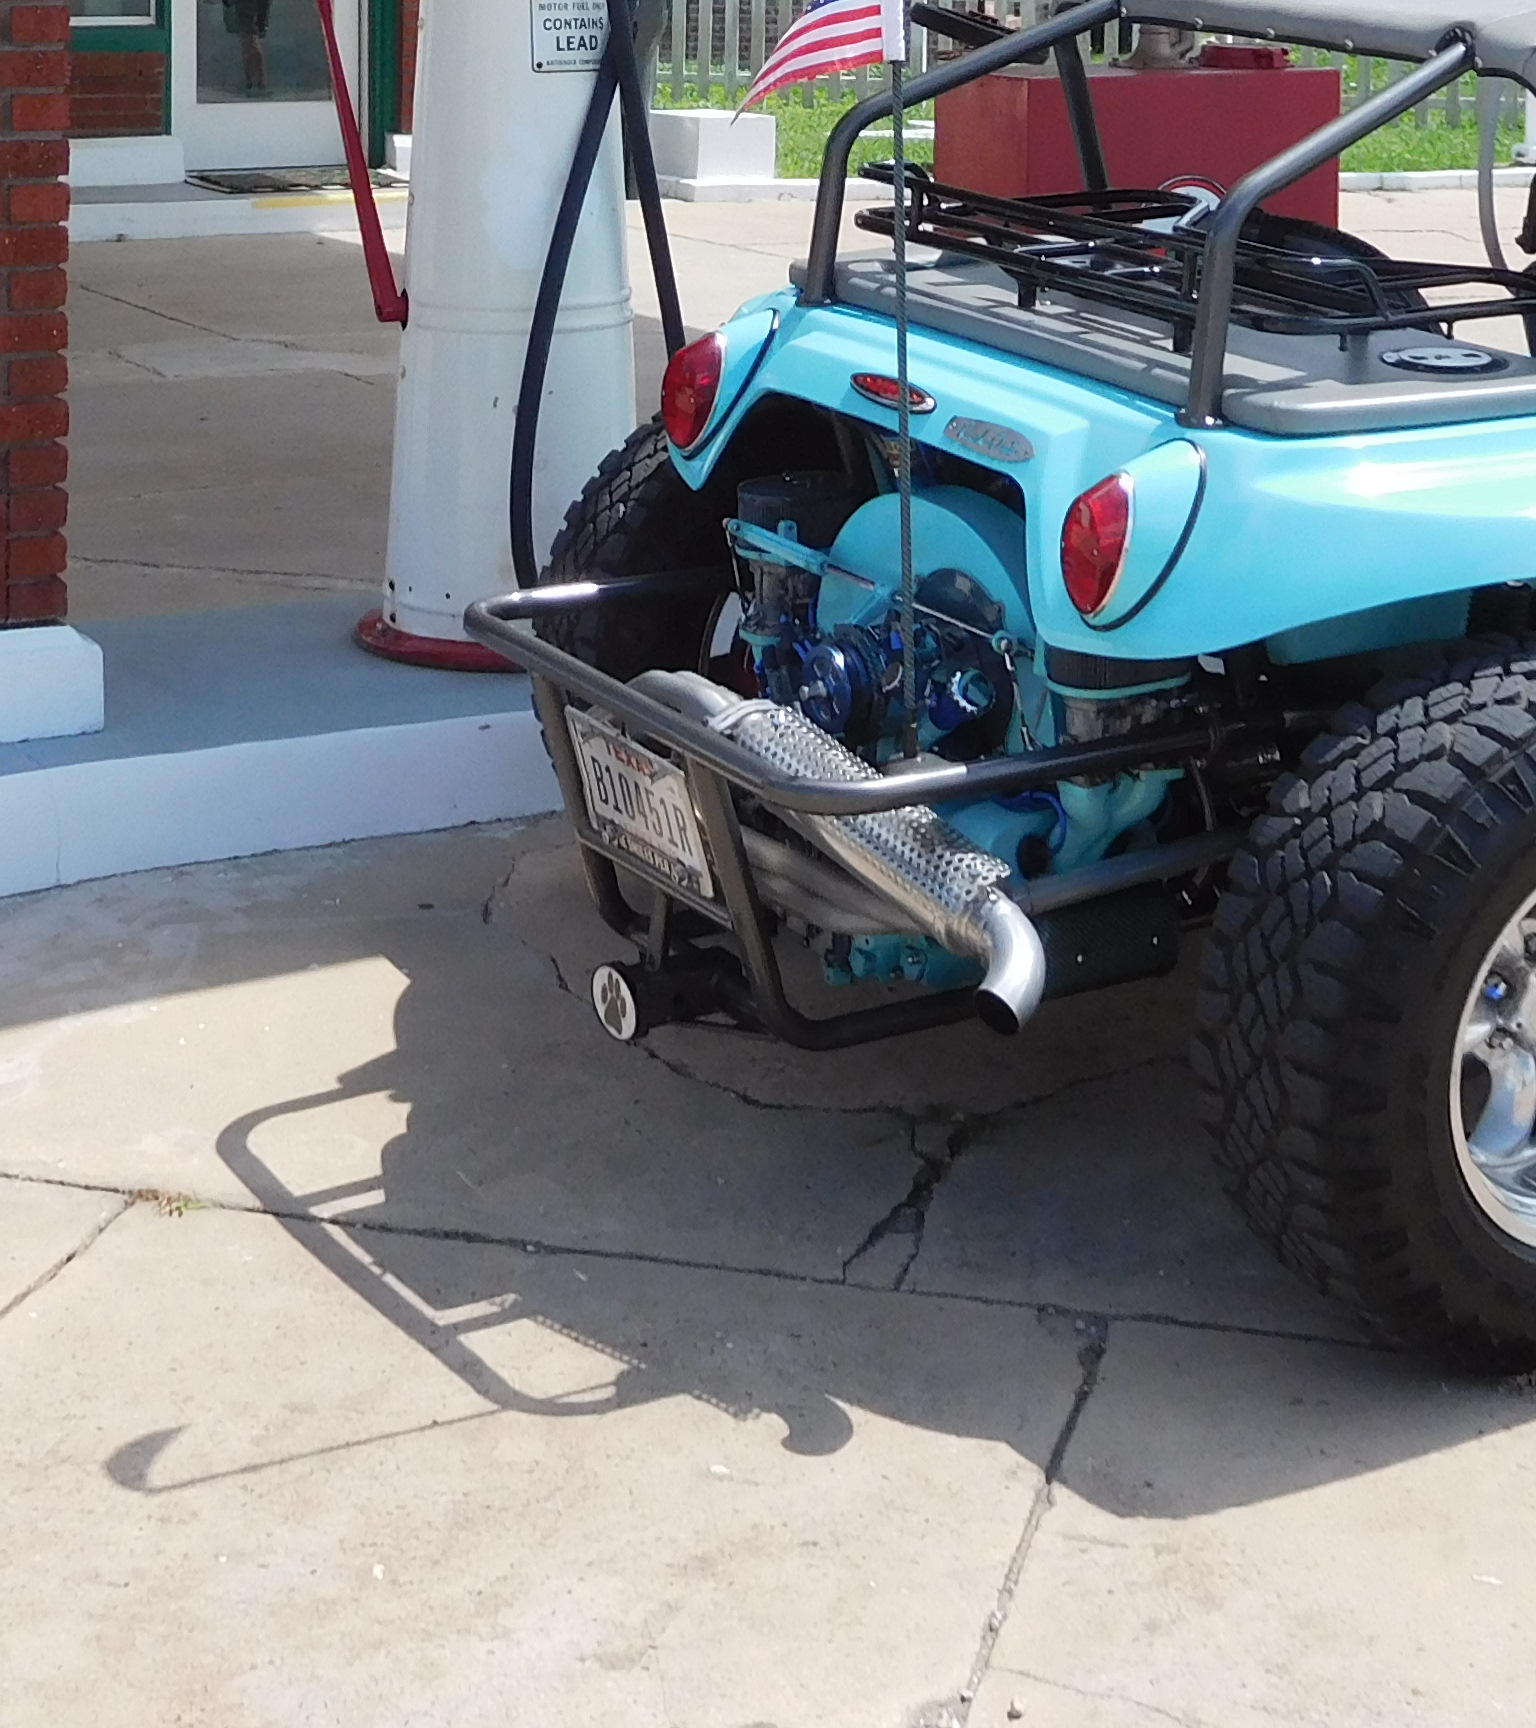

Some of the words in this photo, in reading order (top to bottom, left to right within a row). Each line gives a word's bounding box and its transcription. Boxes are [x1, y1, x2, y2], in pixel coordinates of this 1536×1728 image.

[543, 16, 604, 31] CONTAINS
[556, 34, 599, 52] LEAD
[590, 755, 695, 858] B10451R
